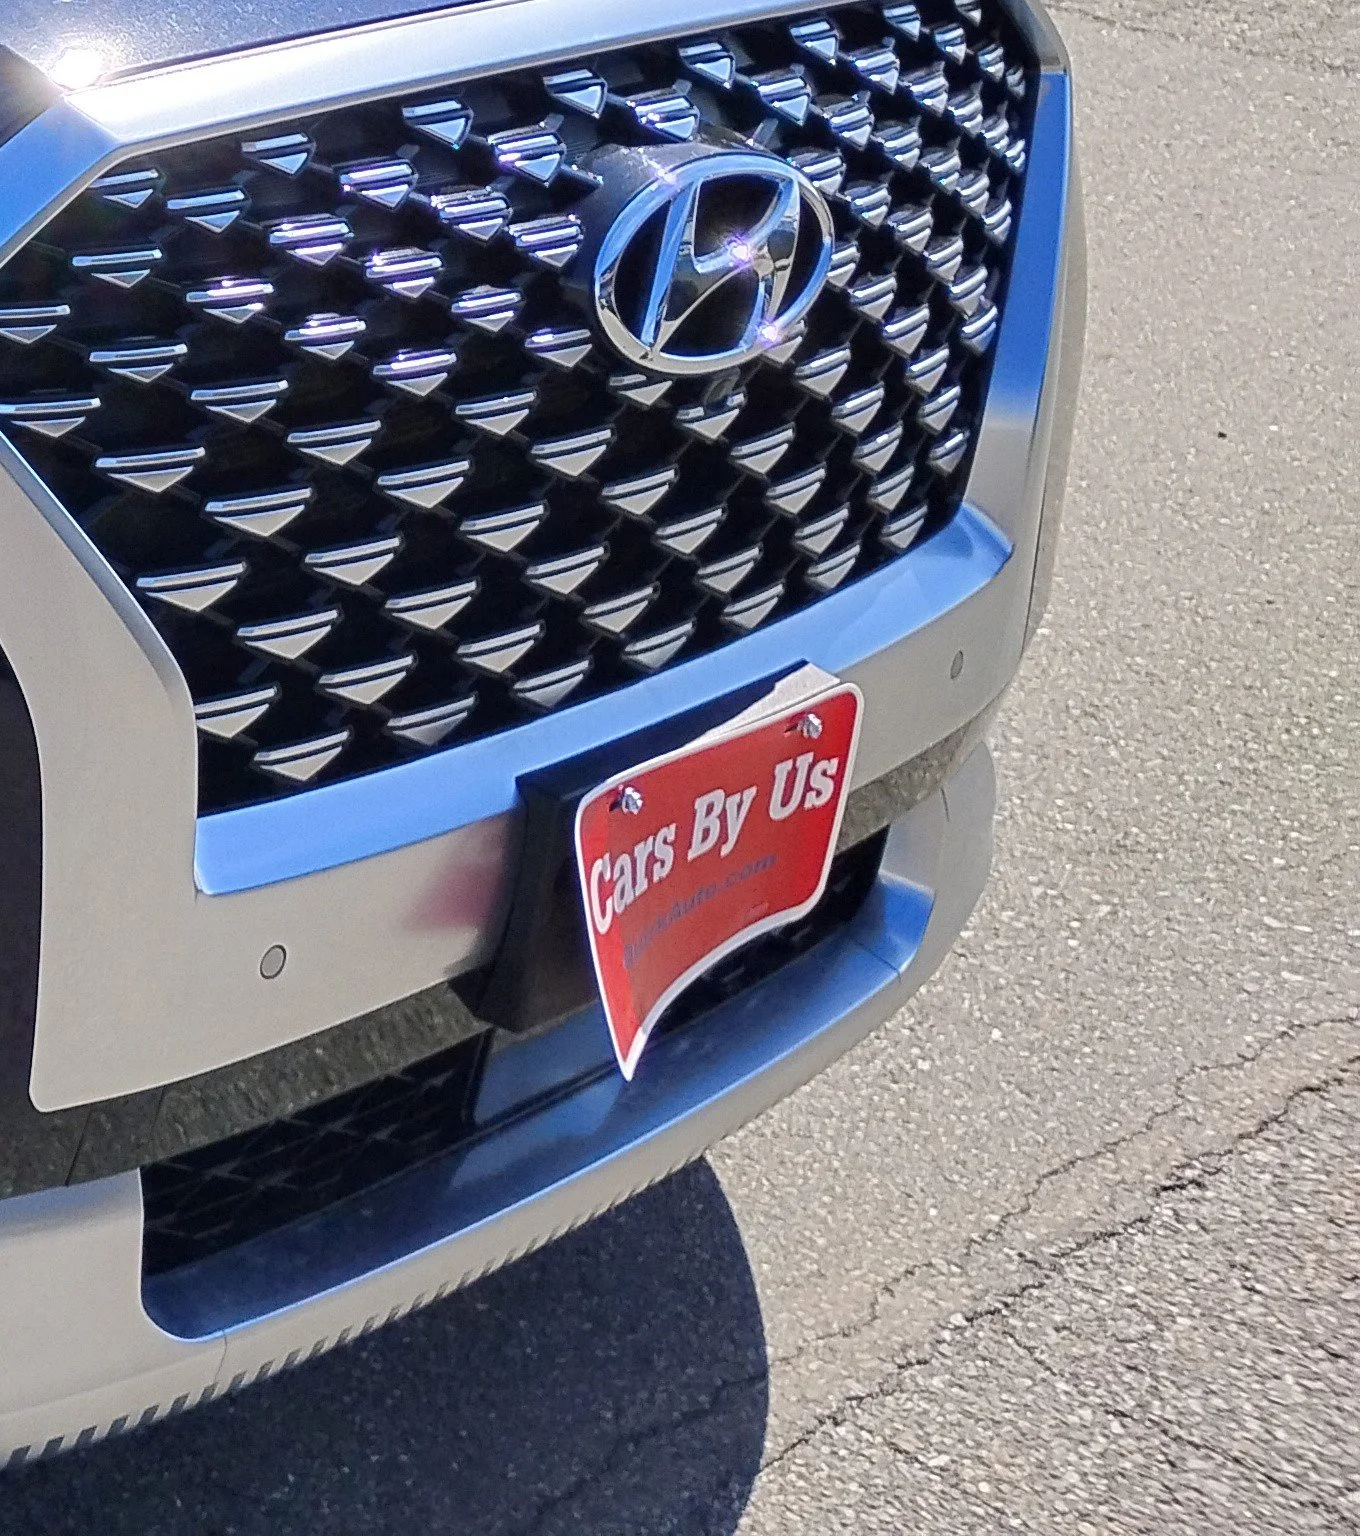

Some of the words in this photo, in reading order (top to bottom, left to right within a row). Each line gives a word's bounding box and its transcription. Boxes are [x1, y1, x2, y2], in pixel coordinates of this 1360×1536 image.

[590, 822, 677, 935] Cars
[687, 785, 758, 863] By
[768, 751, 840, 822] Us
